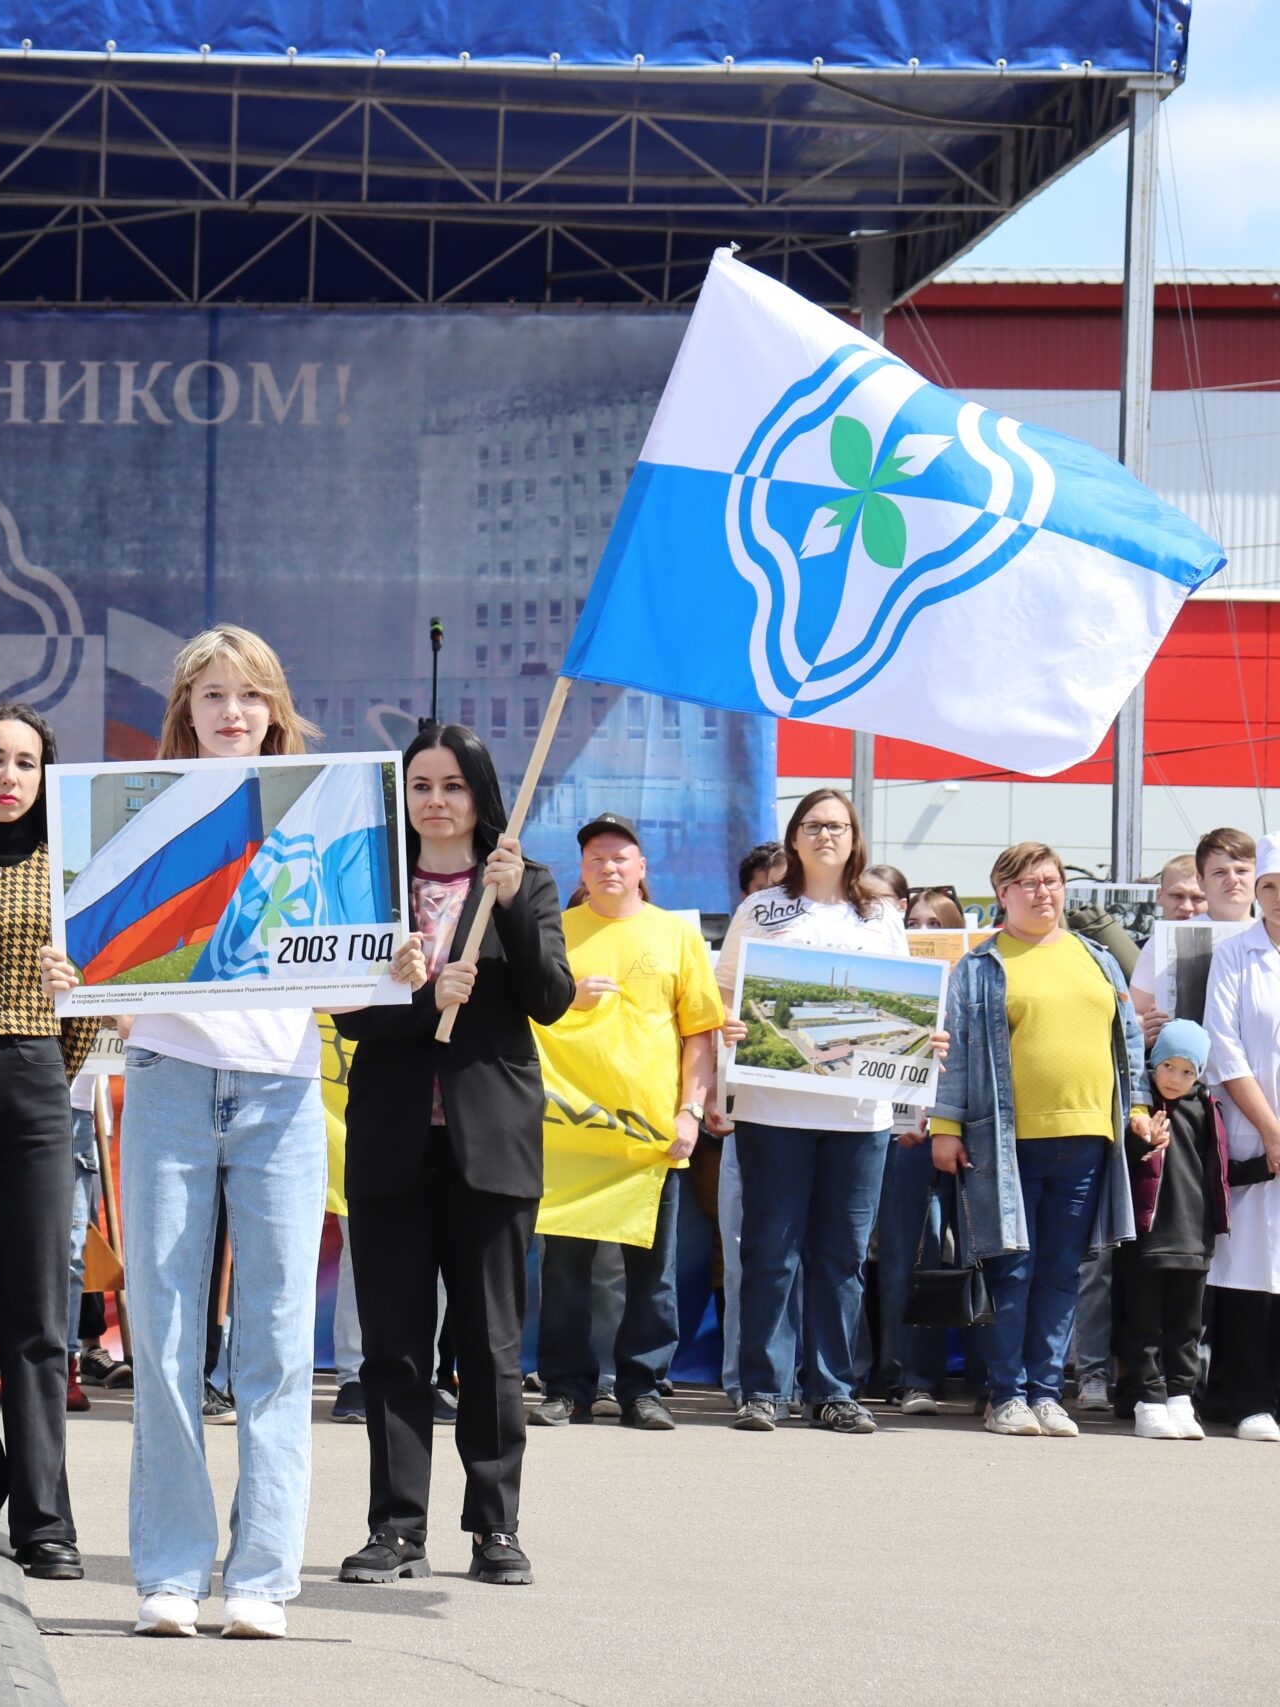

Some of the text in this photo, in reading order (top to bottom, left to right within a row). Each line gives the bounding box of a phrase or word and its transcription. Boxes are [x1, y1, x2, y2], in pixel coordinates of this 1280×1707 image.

[751, 899, 810, 926] Black
[277, 933, 394, 964] 2003 ГОД
[858, 1060, 929, 1084] 2000 ГОД
